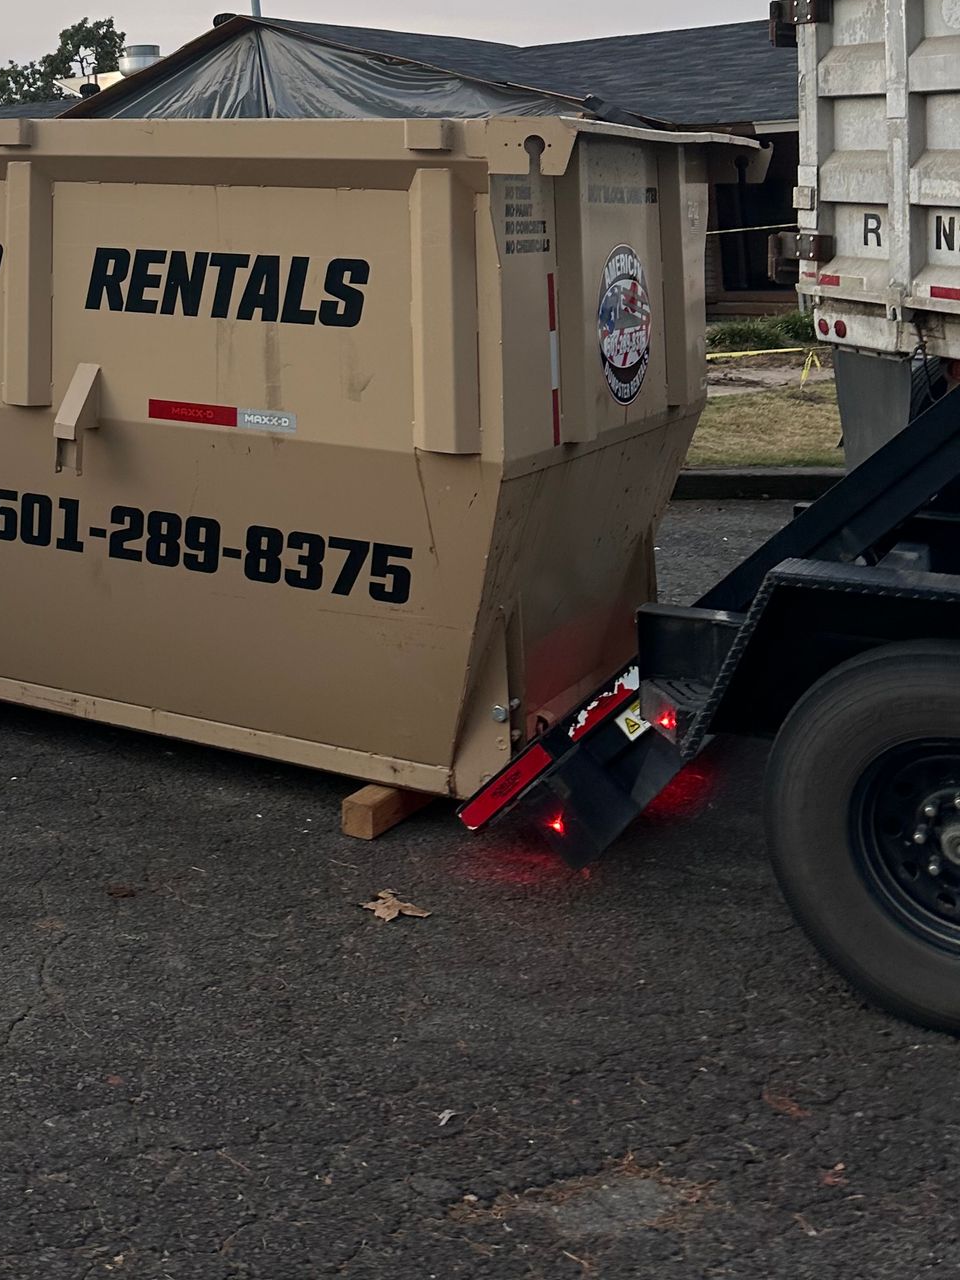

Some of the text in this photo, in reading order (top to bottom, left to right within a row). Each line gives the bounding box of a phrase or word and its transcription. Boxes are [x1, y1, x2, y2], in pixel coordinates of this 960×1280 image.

[505, 204, 533, 217] NO PAINT
[505, 221, 546, 235] NO CONCRETE
[863, 213, 882, 247] R
[505, 240, 515, 254] NO
[605, 253, 642, 290] AMERICAN
[85, 247, 370, 328] RENTALS
[244, 413, 289, 427] MAXX-D
